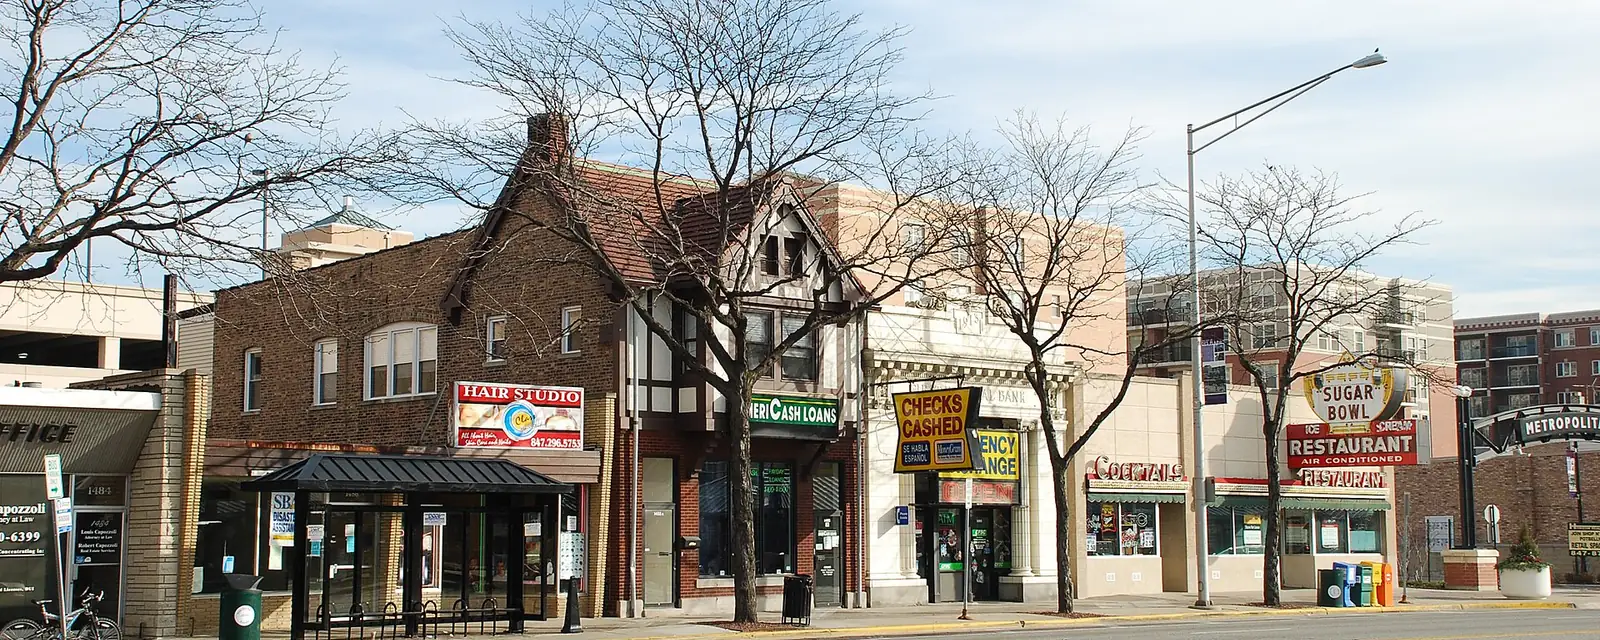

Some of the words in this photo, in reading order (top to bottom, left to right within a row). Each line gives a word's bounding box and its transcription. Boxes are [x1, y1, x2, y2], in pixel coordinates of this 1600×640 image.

[463, 385, 509, 399] HAIR
[514, 388, 580, 403] STUDIO
[1323, 384, 1374, 402] SUGAR
[902, 394, 962, 417] CHECKS
[1328, 403, 1370, 421] BOWL
[804, 406, 837, 423] LOANS
[903, 416, 963, 438] CASHED
[1305, 425, 1320, 435] ICE
[530, 438, 580, 448] 847.296.5753
[903, 445, 910, 453] SE
[911, 444, 929, 453] HABLA
[1289, 436, 1413, 456] RESTAURANT
[1325, 455, 1402, 465] CONDITIONED
[1304, 469, 1387, 488] RESTAURANT
[88, 486, 112, 495] 1484
[274, 494, 295, 510] SB
